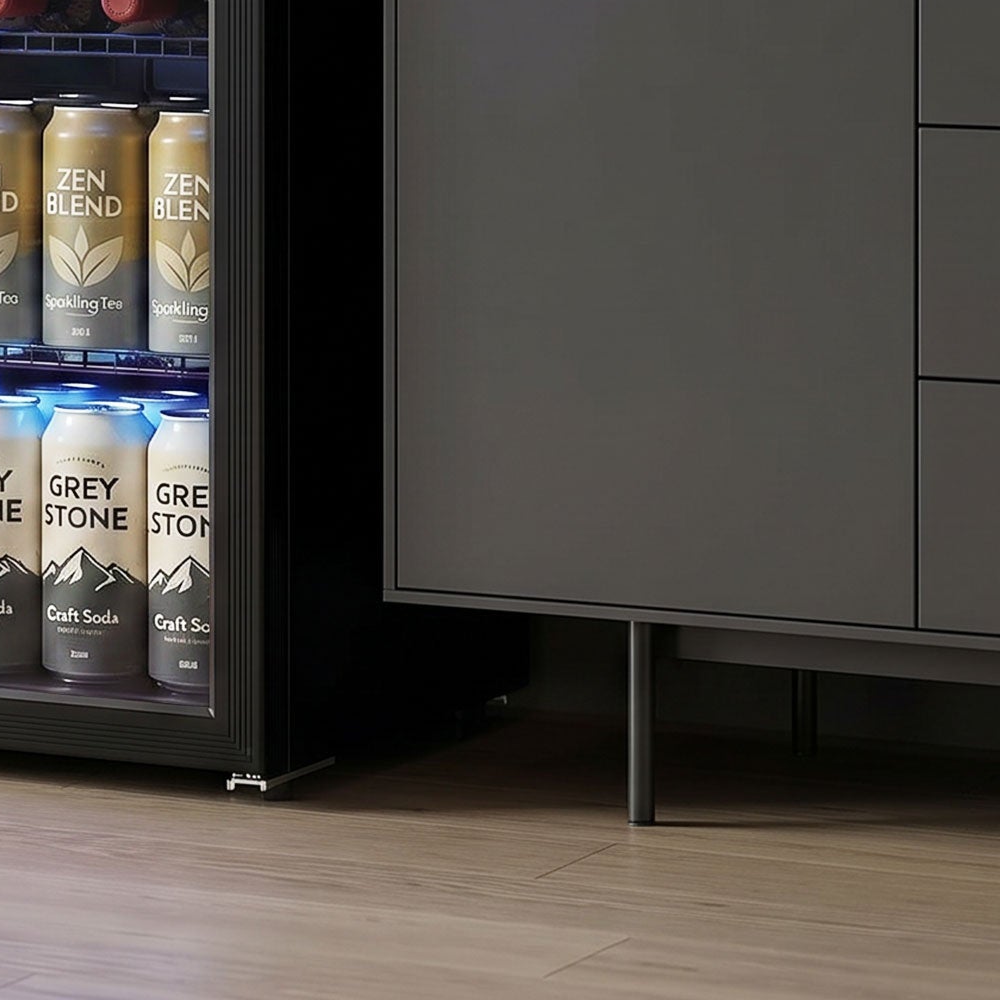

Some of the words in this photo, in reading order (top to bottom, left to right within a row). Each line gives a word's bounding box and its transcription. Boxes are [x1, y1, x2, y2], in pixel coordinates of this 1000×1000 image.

[56, 168, 105, 192] ZEN
[47, 192, 122, 217] BLEND
[50, 475, 119, 500] GREY
[156, 483, 209, 508] GRE
[45, 503, 128, 531] STONE
[47, 604, 79, 623] Craft
[82, 609, 119, 624] Soda
[154, 613, 187, 632] Craft
